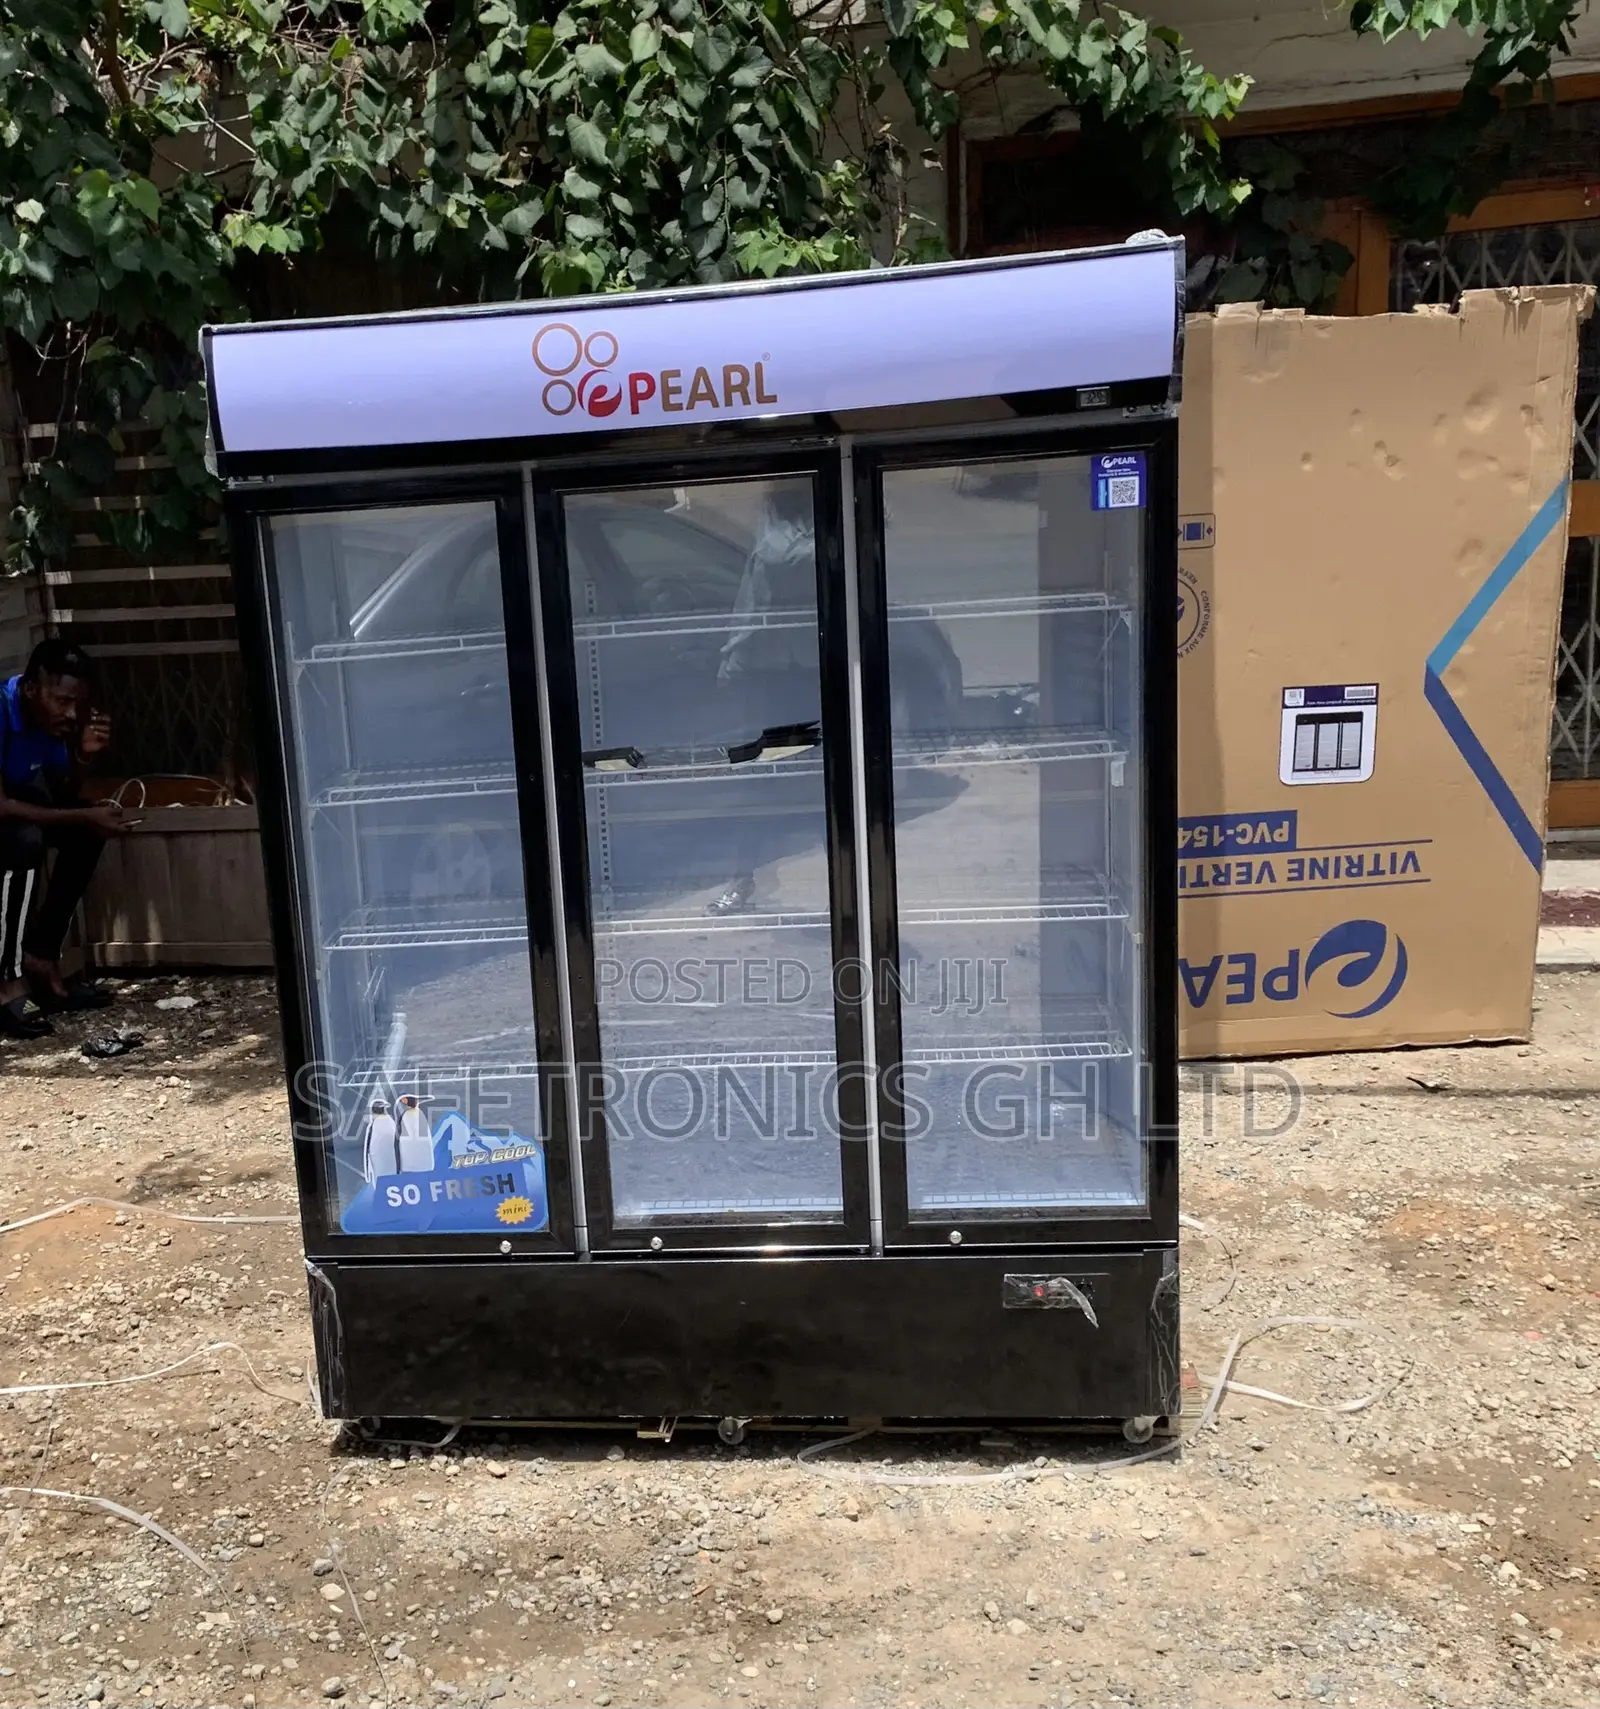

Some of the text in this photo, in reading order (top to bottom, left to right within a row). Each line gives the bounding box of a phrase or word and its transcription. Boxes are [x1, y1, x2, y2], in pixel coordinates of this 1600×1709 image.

[628, 361, 778, 415] PEARL
[1113, 456, 1137, 465] PEARL
[1197, 590, 1211, 639] CONFORME
[1185, 638, 1199, 655] AUX
[1179, 851, 1421, 889] VITRINE VERTI
[1178, 949, 1300, 1008] PEA
[454, 1144, 537, 1169] TOP COOL
[386, 1172, 516, 1208] SO FRESH
[502, 1202, 528, 1216] mini
